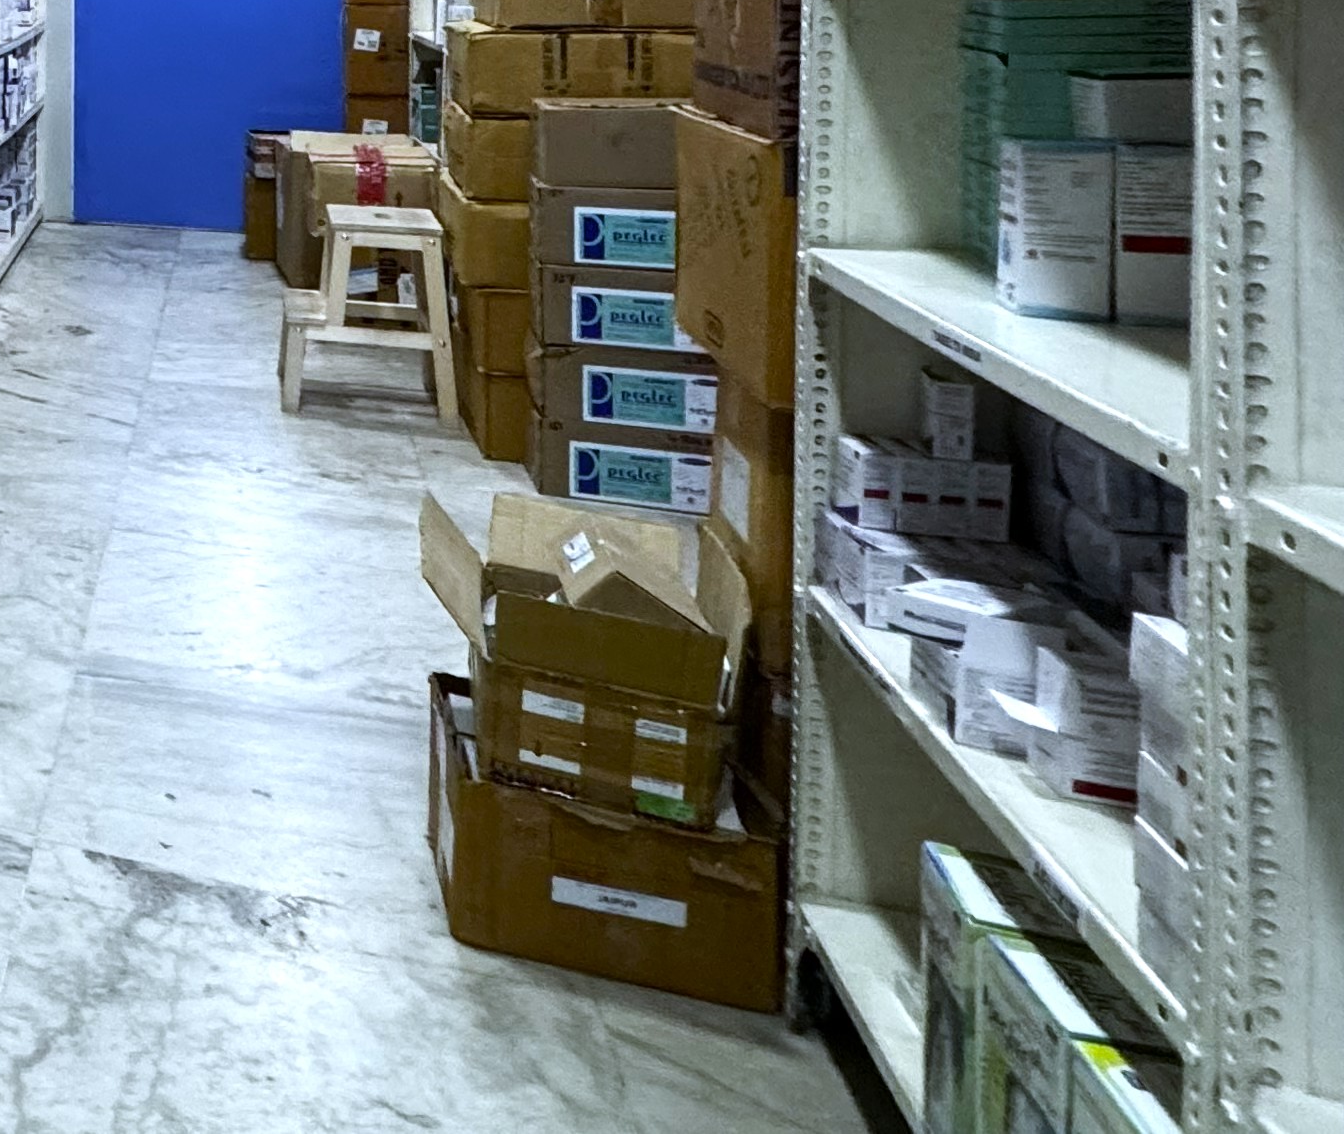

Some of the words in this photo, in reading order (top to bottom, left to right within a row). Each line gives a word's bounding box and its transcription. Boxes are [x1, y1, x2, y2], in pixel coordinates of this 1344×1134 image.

[614, 230, 666, 244] peglec
[611, 310, 662, 324] peglec
[622, 390, 675, 404] peglec
[608, 467, 662, 482] peglec
